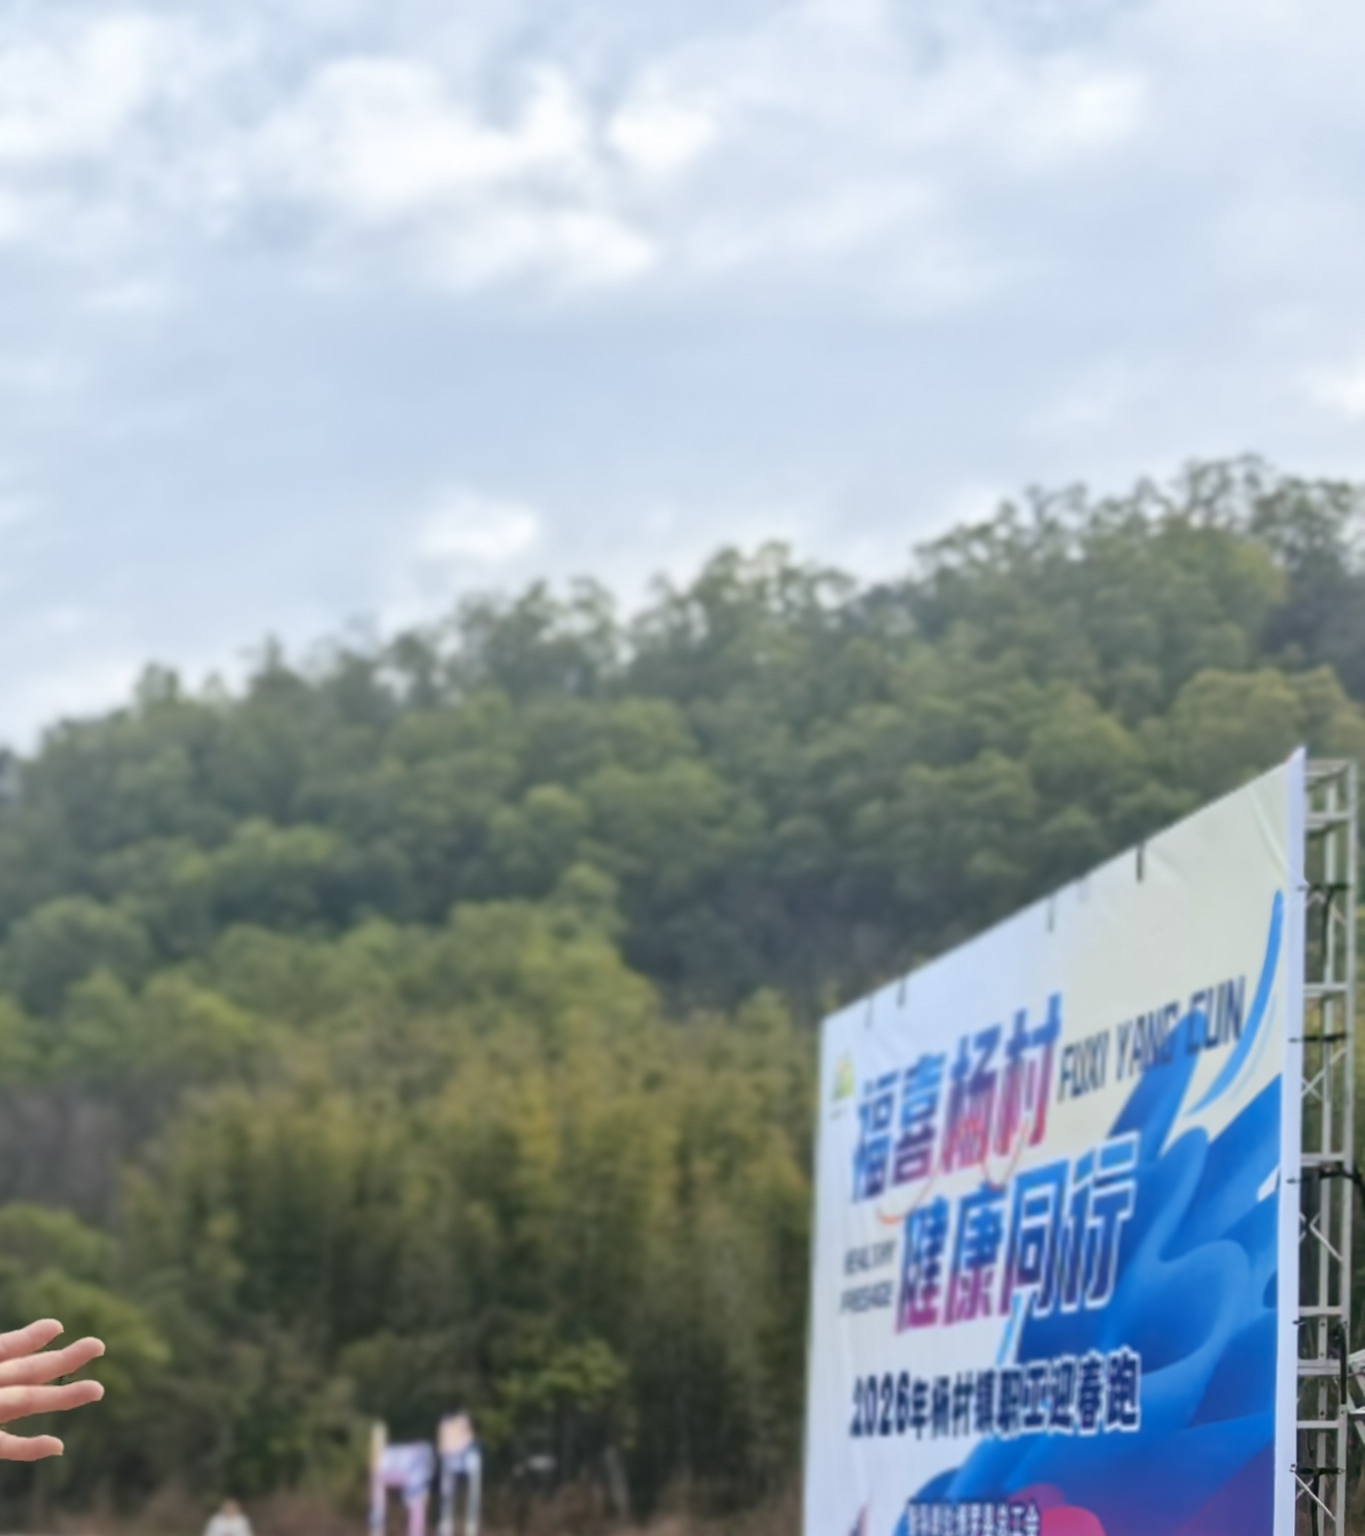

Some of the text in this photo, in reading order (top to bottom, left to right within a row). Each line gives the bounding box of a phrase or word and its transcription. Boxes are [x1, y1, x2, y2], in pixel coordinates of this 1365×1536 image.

[852, 992, 1061, 1203] 福喜杨村
[1116, 1001, 1179, 1082] YANG
[895, 1130, 1140, 1334] 健康同行
